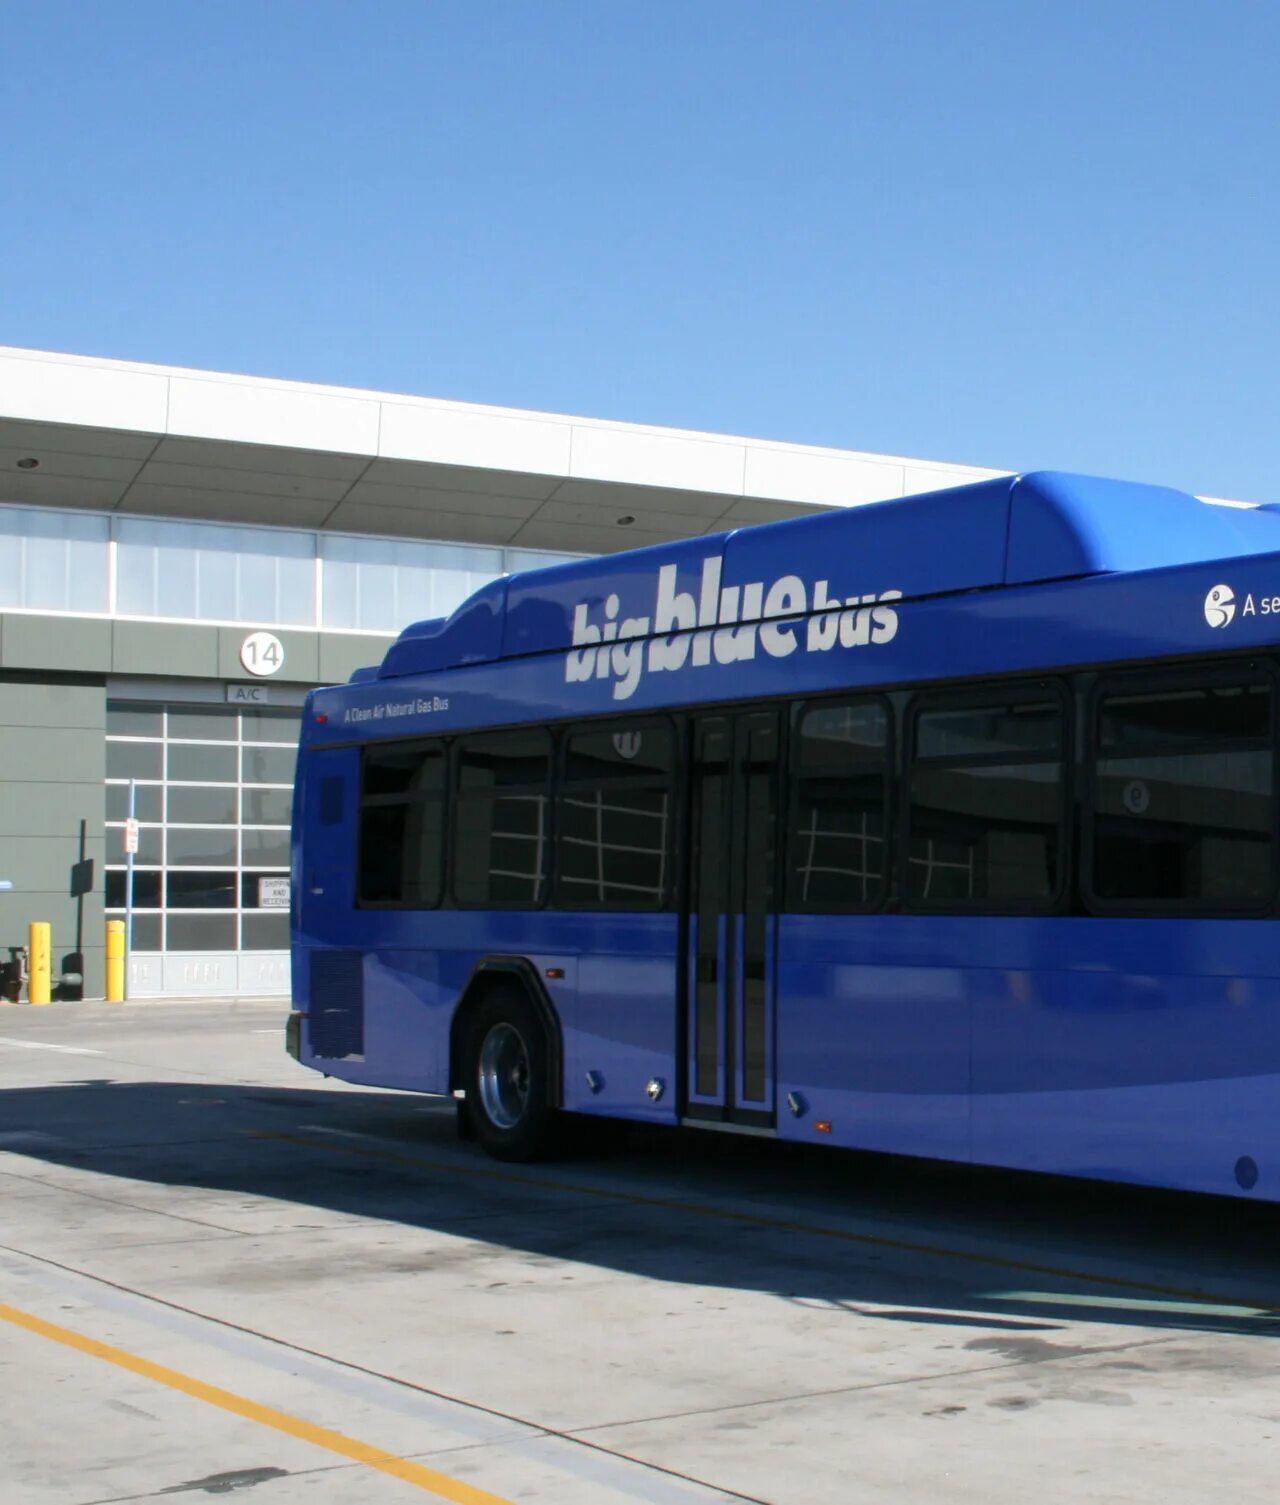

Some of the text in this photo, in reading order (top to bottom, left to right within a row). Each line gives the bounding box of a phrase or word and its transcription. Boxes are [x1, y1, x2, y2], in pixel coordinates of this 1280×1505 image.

[1242, 594, 1256, 617] A
[247, 641, 280, 666] 14
[236, 687, 261, 701] A/C
[351, 707, 372, 722] Clean
[373, 704, 385, 719] Air
[386, 700, 416, 717] Natural
[417, 699, 432, 713] Gas
[433, 696, 449, 711] Bus
